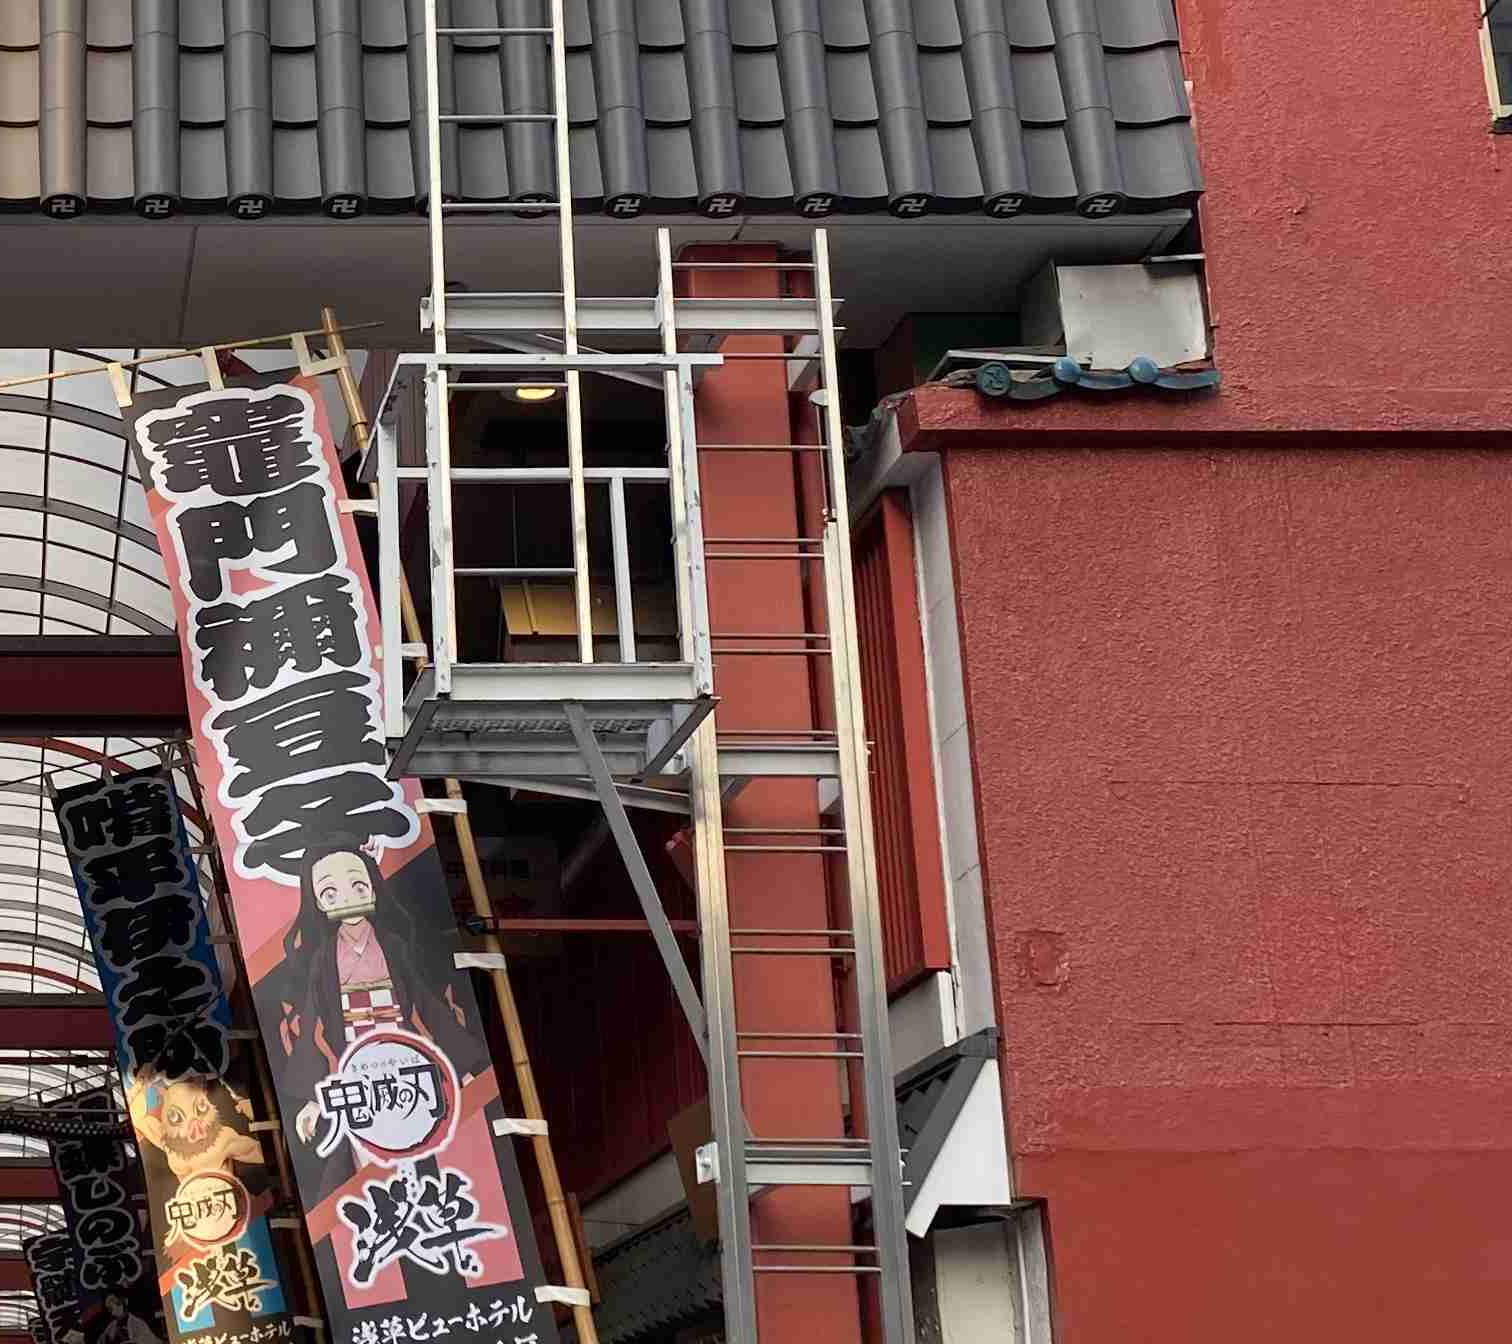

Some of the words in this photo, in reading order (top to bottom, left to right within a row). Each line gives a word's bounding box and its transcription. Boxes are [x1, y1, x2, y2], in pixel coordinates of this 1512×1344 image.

[317, 1064, 445, 1154] 鬼滅の刃
[338, 1168, 507, 1288] 浅草
